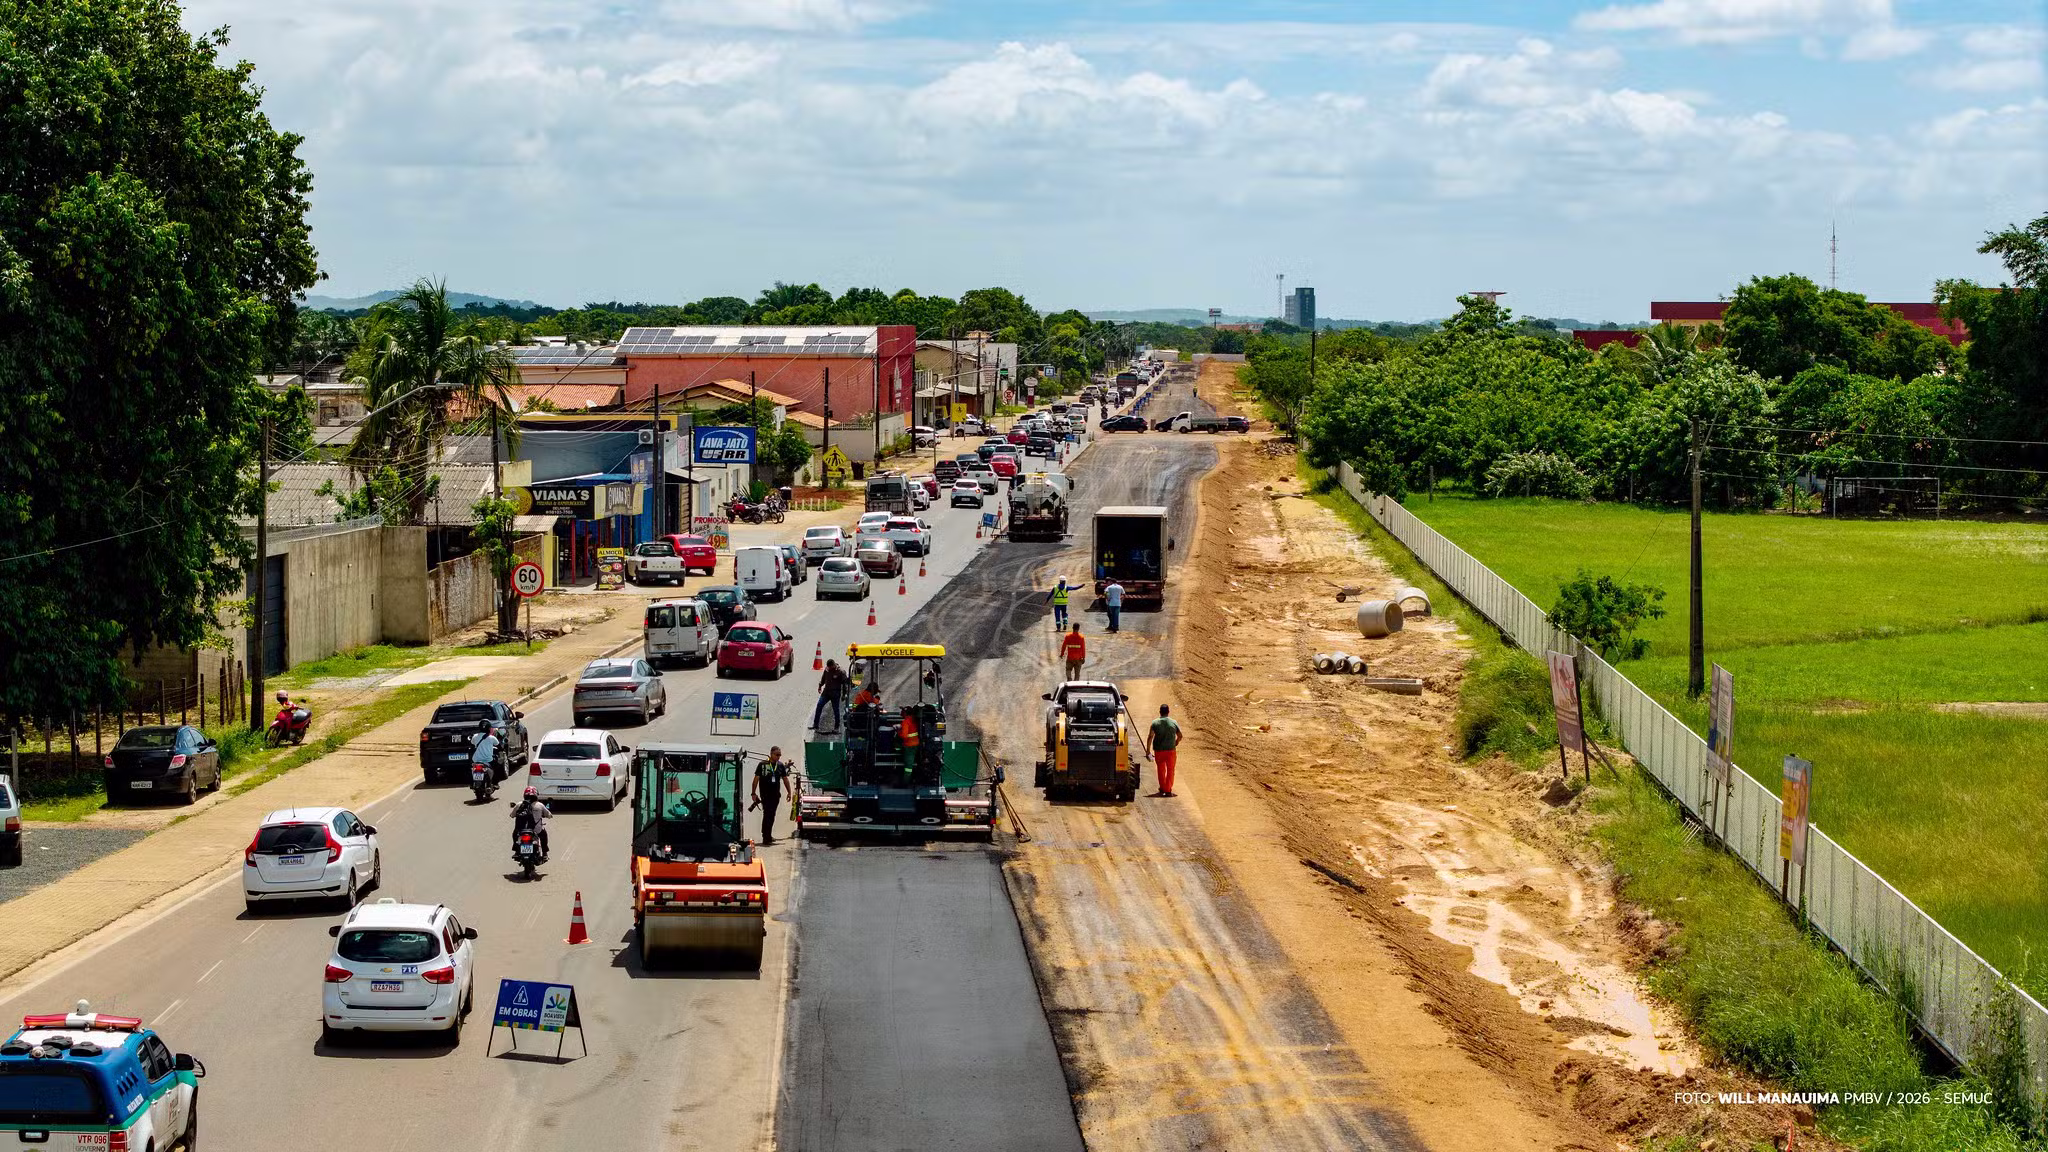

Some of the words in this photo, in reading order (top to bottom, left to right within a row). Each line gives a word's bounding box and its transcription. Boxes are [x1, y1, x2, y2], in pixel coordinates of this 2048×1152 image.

[700, 438, 748, 449] LAVA-JATO
[701, 449, 746, 459] UFRR
[519, 569, 537, 583] 60
[880, 648, 914, 656] VÖGELE
[499, 1006, 511, 1016] EM
[512, 1008, 538, 1018] OBRAS
[77, 1135, 92, 1144] VTR
[94, 1135, 107, 1145] 096
